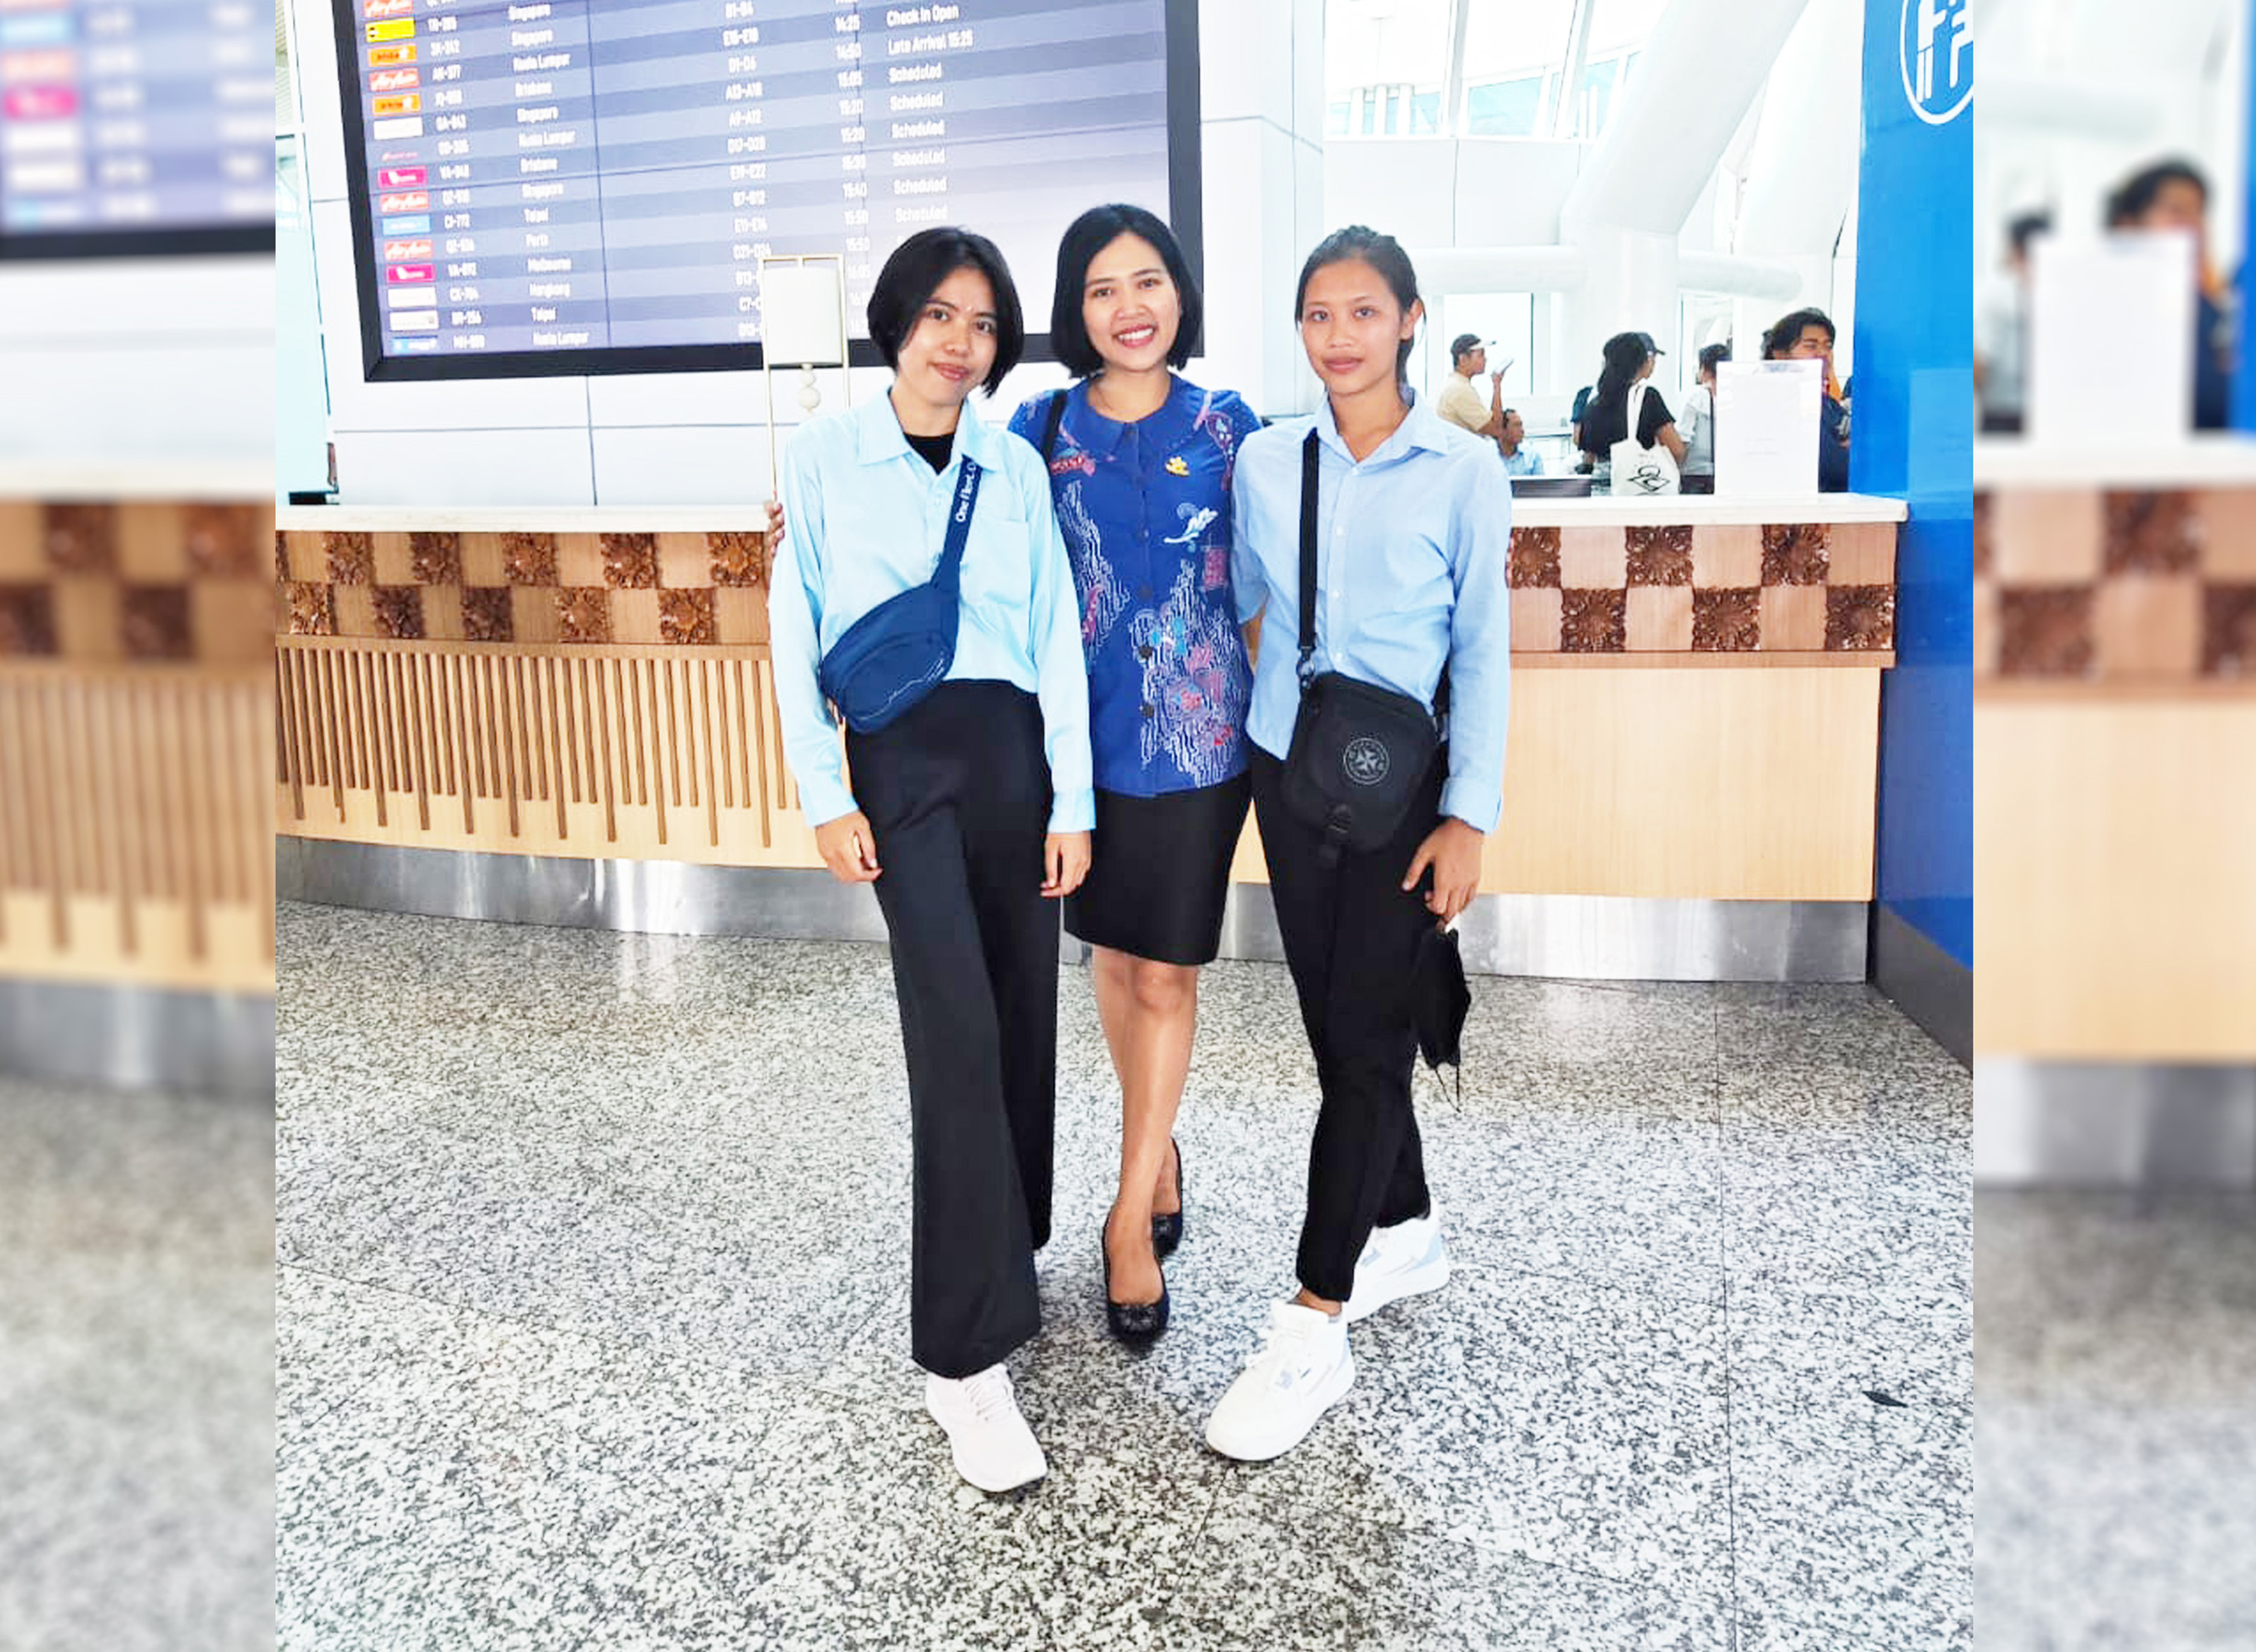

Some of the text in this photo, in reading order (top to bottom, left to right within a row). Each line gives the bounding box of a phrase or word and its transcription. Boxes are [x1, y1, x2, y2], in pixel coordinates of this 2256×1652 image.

[886, 8, 920, 27] Check
[932, 4, 959, 23] Open
[888, 39, 911, 55] Late
[912, 34, 947, 52] Arrival
[889, 62, 942, 83] Scheduled
[890, 91, 943, 111] Scheduled
[892, 120, 945, 139] Scheduled
[892, 148, 945, 167] Scheduled
[893, 176, 947, 195] Scheduled
